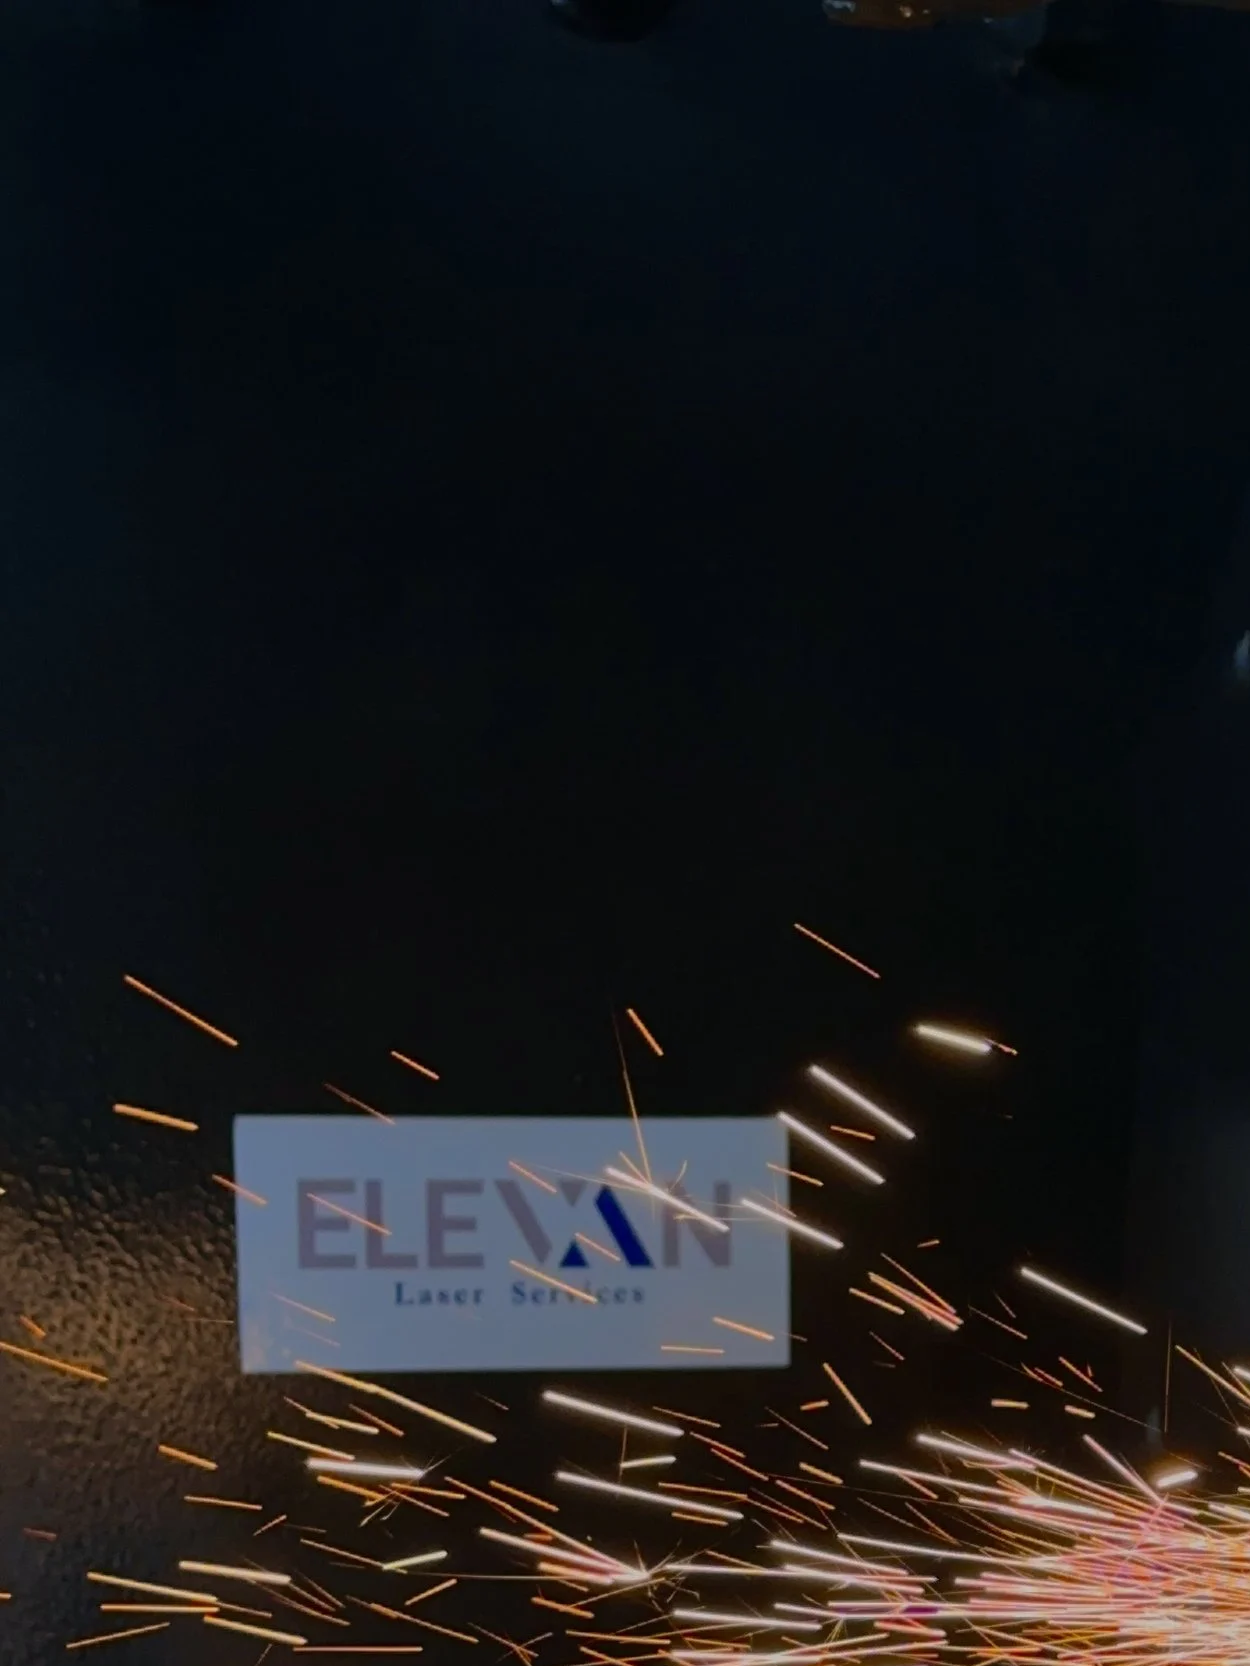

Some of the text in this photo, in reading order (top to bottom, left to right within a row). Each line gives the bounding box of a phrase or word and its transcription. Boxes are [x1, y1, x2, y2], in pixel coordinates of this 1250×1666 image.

[297, 1178, 732, 1269] ELEVAN
[395, 1281, 645, 1306] Laser Services
